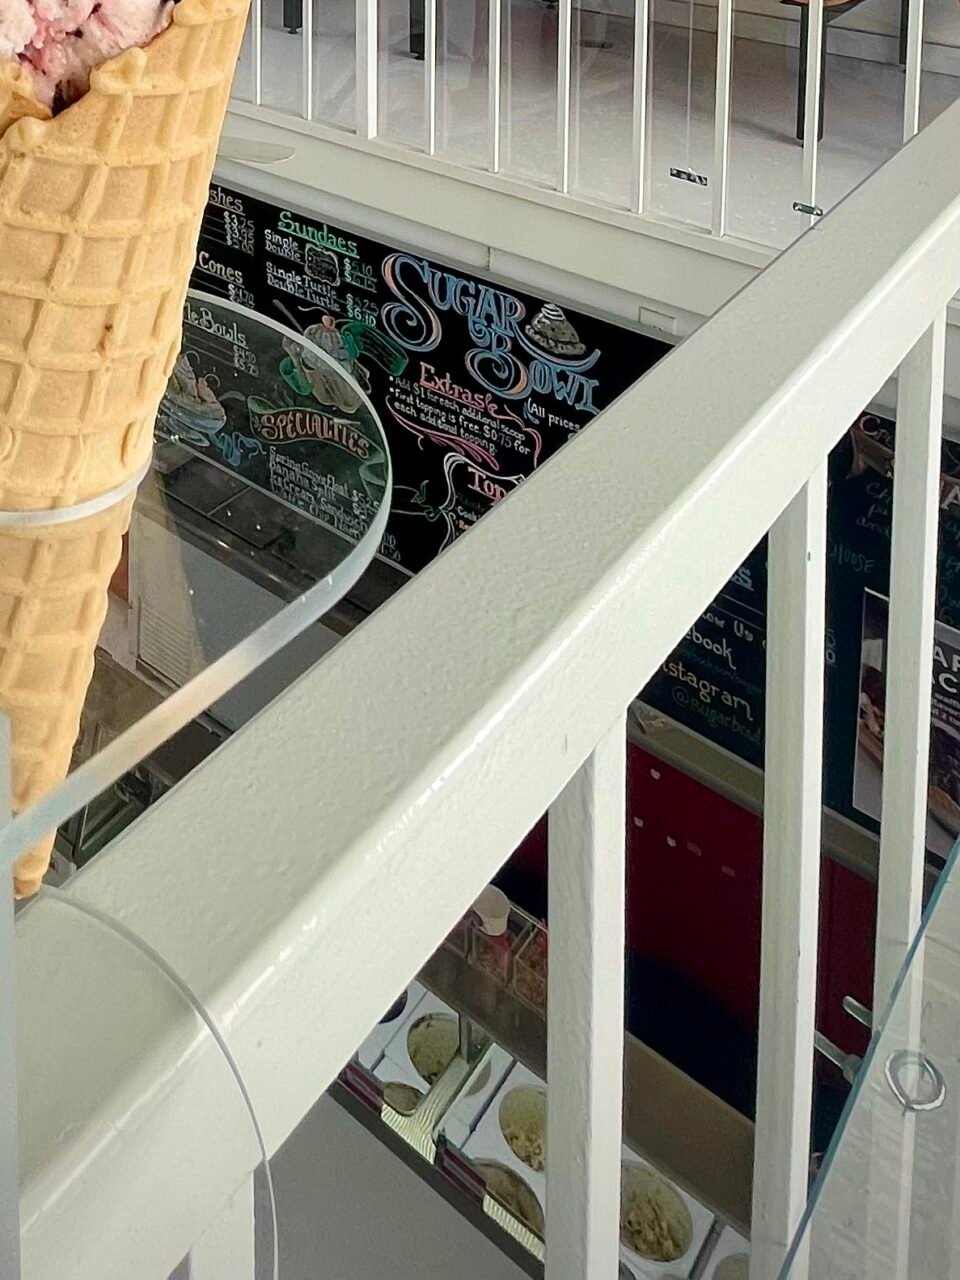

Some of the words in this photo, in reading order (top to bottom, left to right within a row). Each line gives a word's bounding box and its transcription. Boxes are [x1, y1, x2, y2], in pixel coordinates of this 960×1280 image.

[209, 186, 244, 213] shes
[265, 229, 299, 251] Single
[265, 240, 301, 263] Double
[278, 210, 359, 256] Sundaes
[198, 251, 244, 285] Cones
[266, 261, 302, 285] Single
[302, 275, 337, 299] Turtle
[266, 273, 306, 298] Double
[305, 288, 341, 312] Turtle
[381, 253, 526, 352] SUGAR
[200, 307, 247, 345] Bowls
[418, 361, 485, 408] Extras
[464, 324, 600, 415] BOWL
[260, 411, 370, 459] SPECIALTIES
[395, 390, 414, 406] First
[513, 439, 531, 455] for
[687, 625, 737, 670] book
[662, 660, 754, 721] stagram
